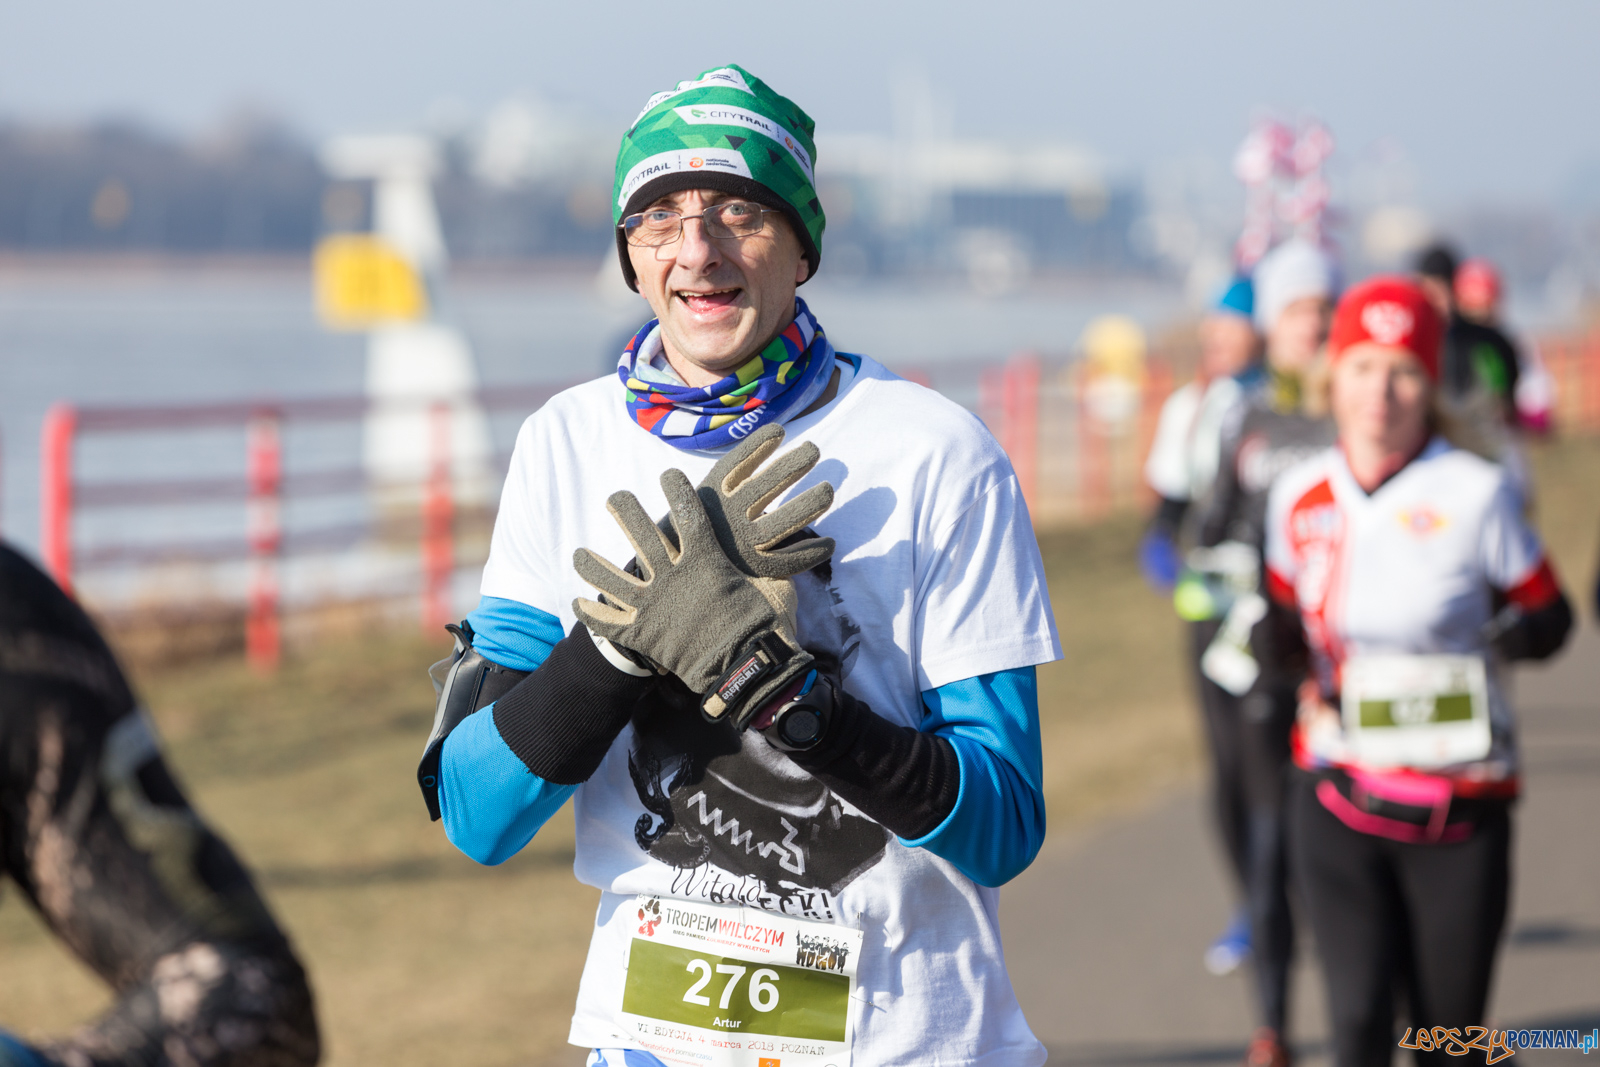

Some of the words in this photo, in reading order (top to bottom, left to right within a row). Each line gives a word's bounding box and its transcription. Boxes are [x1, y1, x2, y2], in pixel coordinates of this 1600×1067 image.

[728, 401, 770, 439] CISOW
[722, 663, 761, 700] Thinsulate
[682, 958, 780, 1013] 276
[637, 1022, 649, 1034] VI
[654, 1025, 693, 1042] EDYCJA
[698, 1034, 706, 1044] 4
[710, 1039, 742, 1050] marca
[747, 1040, 774, 1052] 2018
[780, 1042, 826, 1056] POZNAŃ
[712, 1016, 742, 1029] Artur
